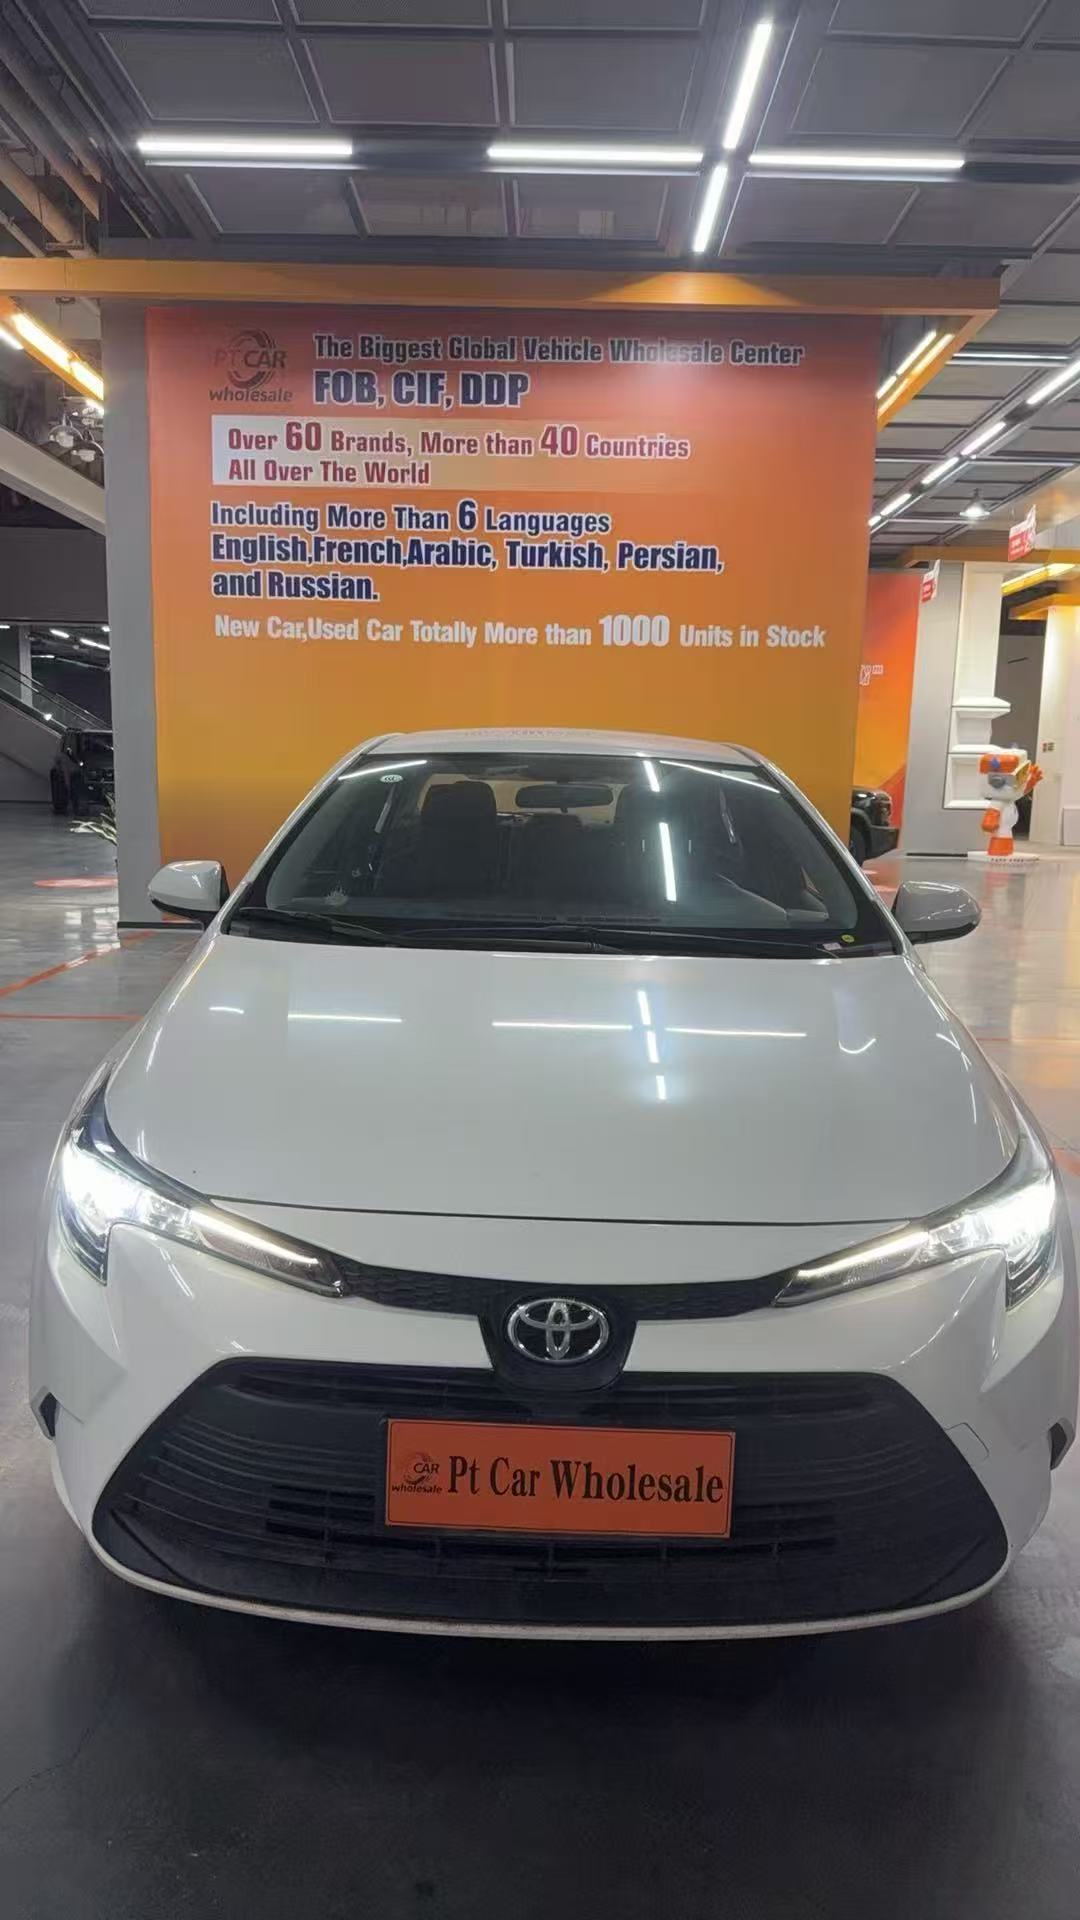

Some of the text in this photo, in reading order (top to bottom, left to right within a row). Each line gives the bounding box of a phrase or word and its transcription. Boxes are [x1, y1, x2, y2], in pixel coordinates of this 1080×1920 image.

[314, 334, 804, 365] The Biggest Global Vehicle Wholesale Center
[208, 387, 293, 402] wholesale
[313, 369, 530, 409] FOB, CIF, DDP
[228, 421, 690, 459] Over 60 Brands, More than 40 Countries
[228, 459, 431, 485] All Over The World
[211, 498, 612, 537] Including More Than 6 Languages
[504, 539, 611, 574] Turkish,
[616, 542, 725, 576] Persian,
[212, 571, 380, 602] and Russian.
[214, 614, 260, 638] New
[366, 618, 403, 643] Car
[410, 619, 477, 648] Totally
[484, 621, 538, 645] More
[545, 624, 592, 647] than
[599, 614, 671, 648] 1000
[679, 624, 733, 649] Units
[739, 624, 759, 648] in
[766, 625, 827, 649] Stock
[413, 1462, 440, 1474] CAR
[448, 1455, 725, 1504] Pt Car Wholesale
[391, 1483, 443, 1495] wholesale
